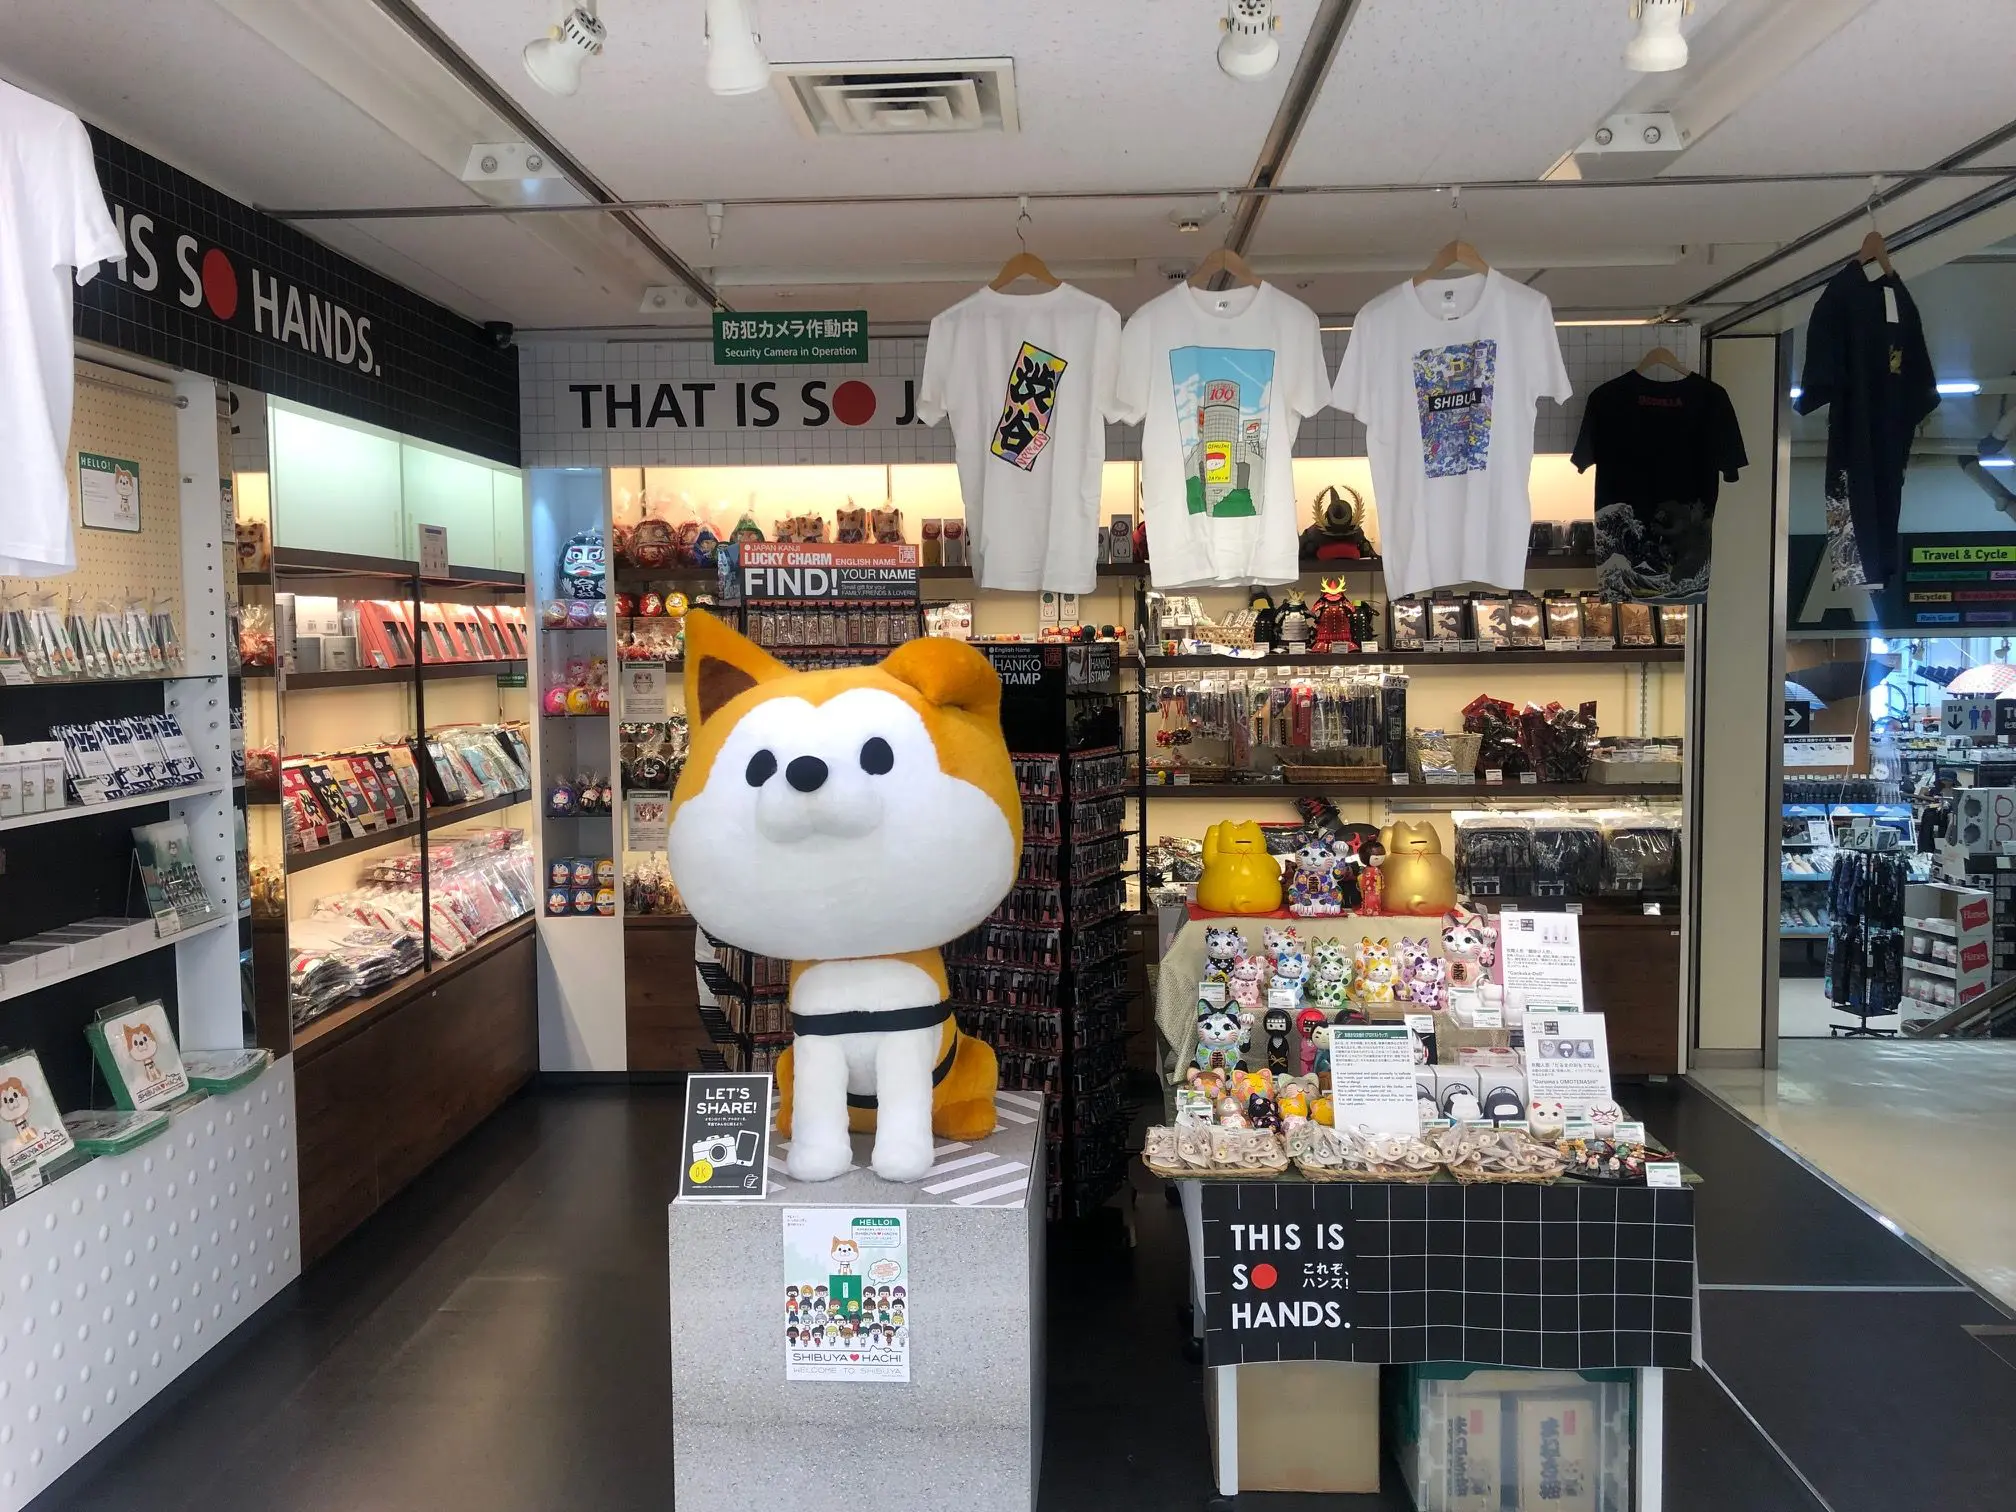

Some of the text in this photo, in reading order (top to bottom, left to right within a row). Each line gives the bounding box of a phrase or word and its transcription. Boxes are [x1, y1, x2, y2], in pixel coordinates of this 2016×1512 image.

[252, 267, 381, 377] HANDS.
[721, 319, 859, 340] 防犯カメラ作動中
[725, 346, 858, 359] Security Camera in Operation
[568, 383, 716, 429] THAT
[736, 381, 780, 428] IS
[80, 456, 112, 472] HELLO!
[751, 544, 777, 552] JAPAN
[744, 552, 897, 566] LUCKY CHARM ENGLISH NAME
[1922, 549, 2008, 561] Travel & Cycle
[841, 569, 916, 580] YOUR NAME
[744, 568, 839, 596] FIND!
[1913, 593, 1947, 601] Bicycles
[994, 659, 1042, 672] HANKO
[1090, 657, 1111, 669] HANKO
[1090, 671, 1111, 684] STAMP
[705, 1087, 751, 1100] LET'S
[696, 1101, 757, 1115] SHARE!
[10, 1147, 39, 1167] SHIBUYA
[1230, 1223, 1345, 1251] THIS IS
[1303, 1262, 1349, 1275] これぞ、
[1231, 1301, 1351, 1330] HANDS.
[792, 1352, 901, 1363] SHIBUYA HACHI
[843, 1367, 856, 1375] TO
[860, 1367, 902, 1375] SHIBUYA
